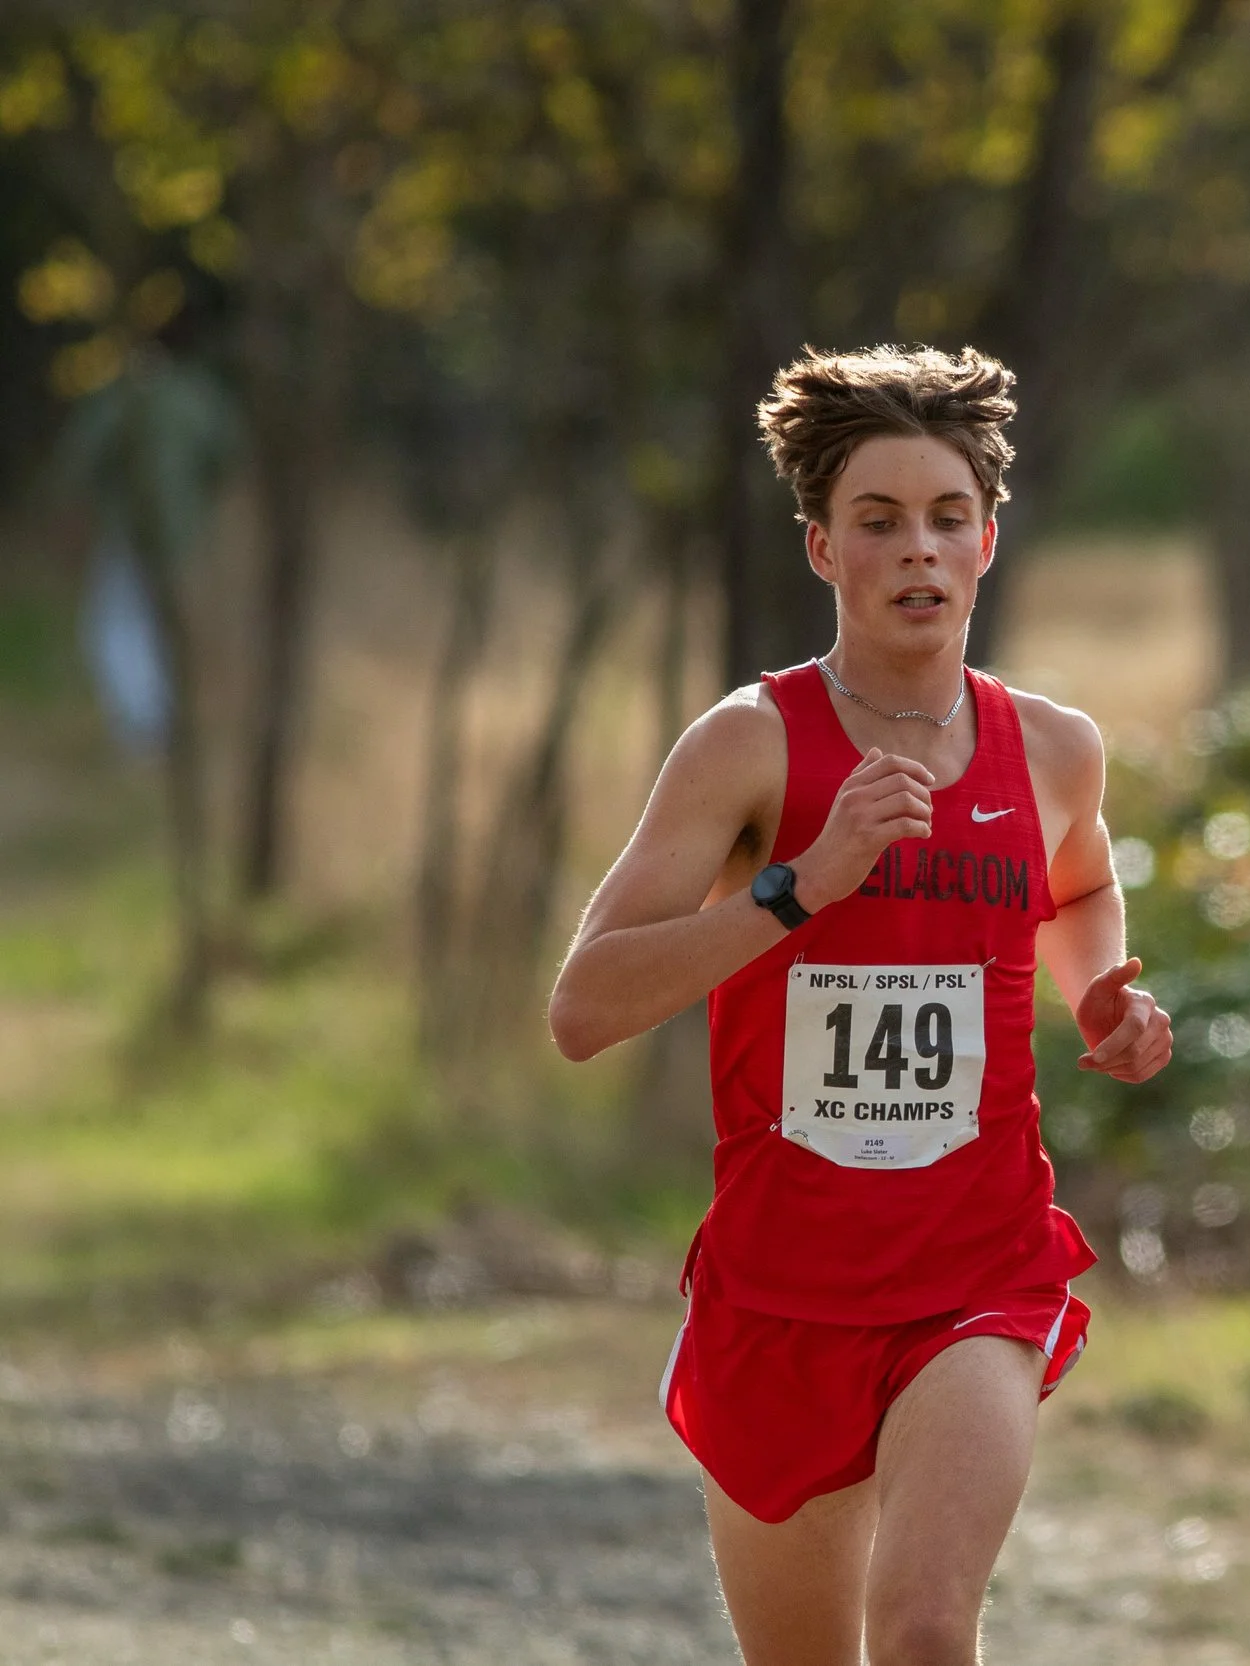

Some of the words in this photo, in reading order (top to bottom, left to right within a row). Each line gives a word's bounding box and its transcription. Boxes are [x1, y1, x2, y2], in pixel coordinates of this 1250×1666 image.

[810, 973, 858, 989] NPSL
[863, 975, 871, 991] /
[875, 974, 918, 990] SPSL
[923, 974, 931, 990] /
[935, 974, 966, 989] PSL
[823, 1002, 954, 1091] 149
[813, 1099, 845, 1119] XC
[854, 1102, 954, 1121] CHAMPS
[865, 1139, 884, 1147] #149
